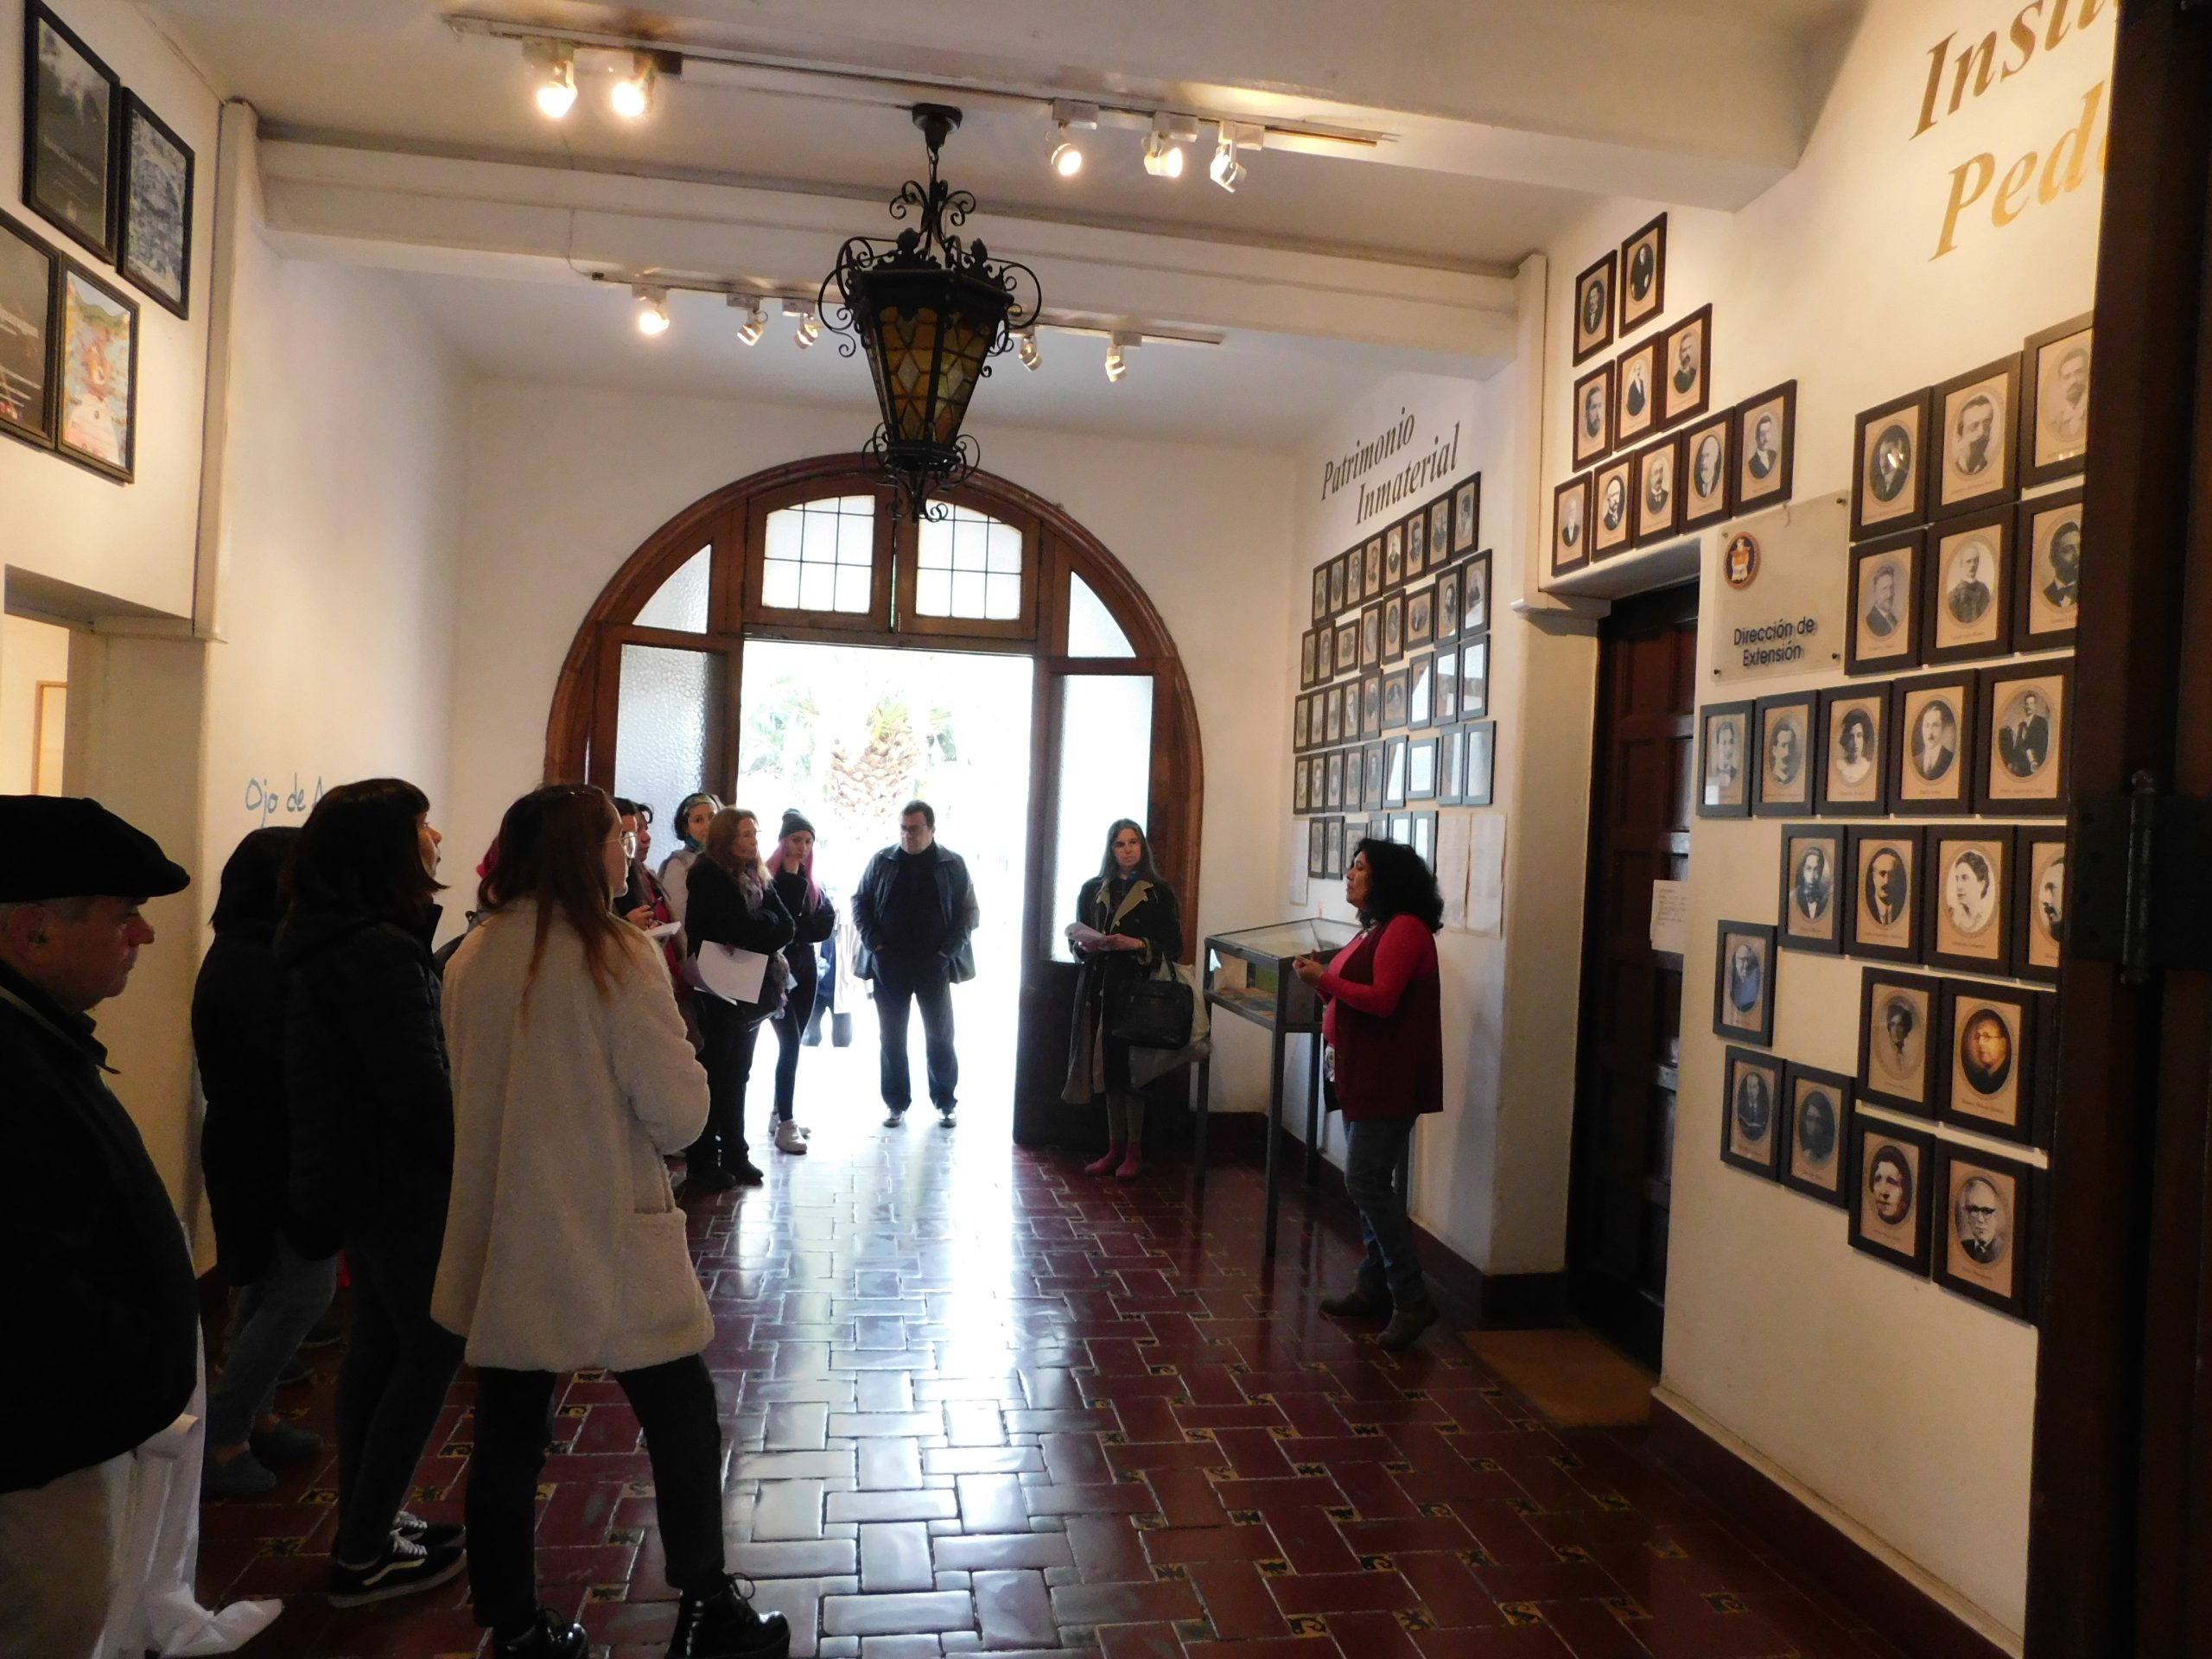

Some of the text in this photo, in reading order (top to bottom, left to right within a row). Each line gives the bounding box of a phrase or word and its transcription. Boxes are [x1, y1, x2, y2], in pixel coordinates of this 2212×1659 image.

[1929, 80, 2108, 262] Ped
[1320, 406, 1415, 502] Patrimonio
[1355, 420, 1461, 525] Inmaterial
[1734, 616, 1815, 645] Dirección de
[1743, 640, 1802, 667] Extensión
[245, 778, 278, 830] Ojo
[286, 772, 306, 812] de
